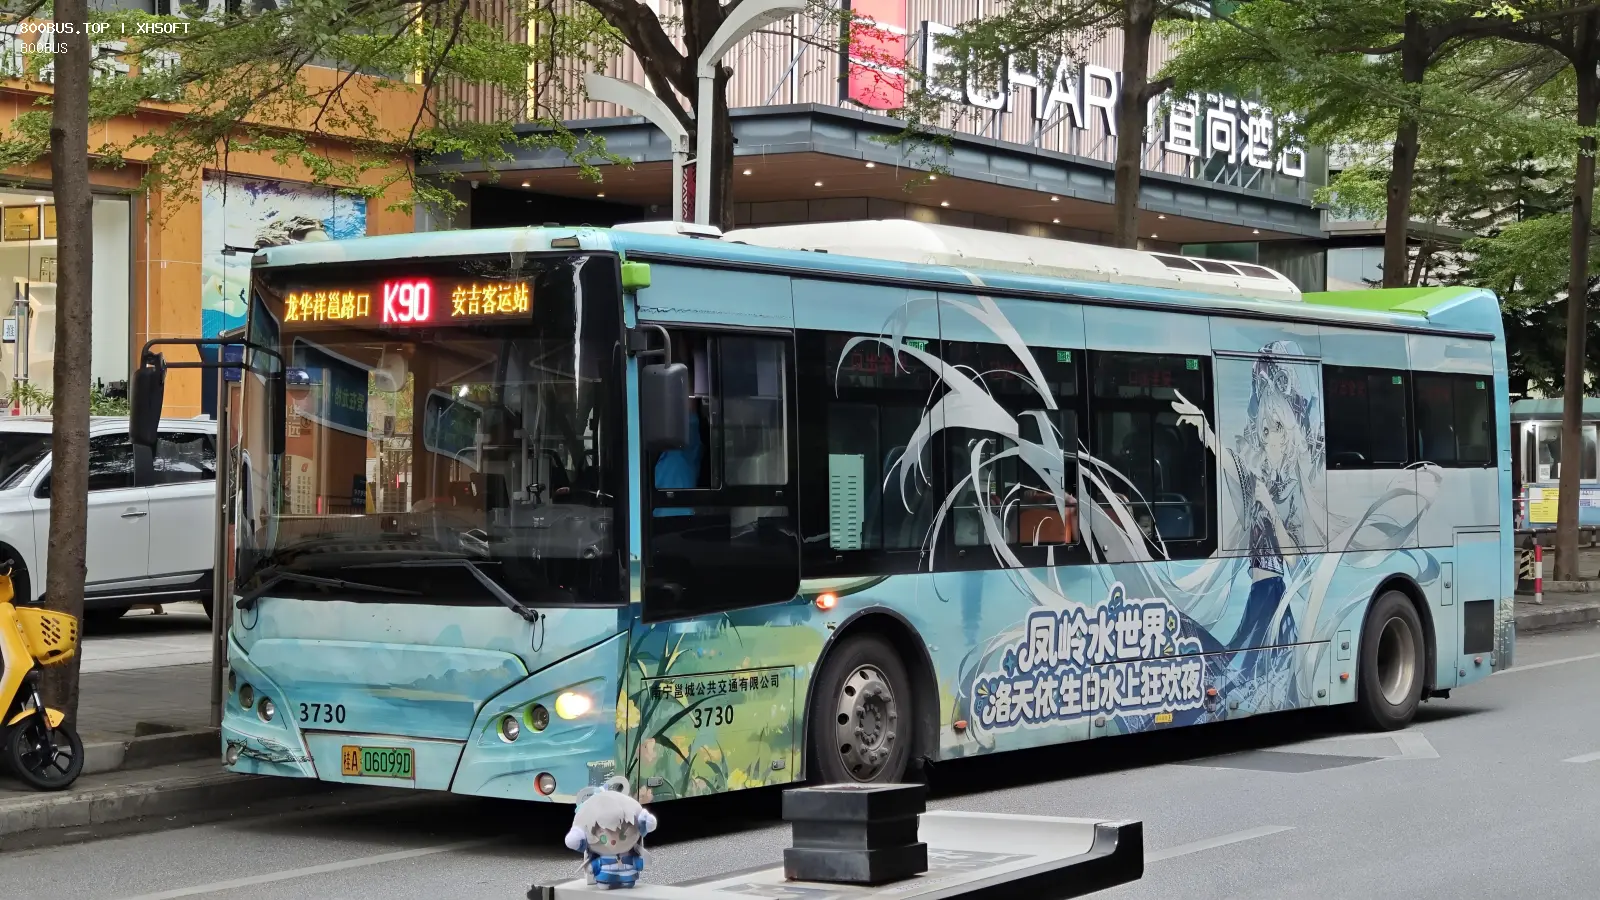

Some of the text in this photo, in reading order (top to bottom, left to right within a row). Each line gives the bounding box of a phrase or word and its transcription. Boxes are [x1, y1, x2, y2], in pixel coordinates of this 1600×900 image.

[284, 290, 370, 322] 龙华祥邕路口
[382, 281, 431, 323] K90
[451, 282, 529, 317] 安吉客运站
[1018, 608, 1166, 672] 凤岭水世界
[651, 674, 780, 701] 南宁邕城公共交通有限公司
[983, 662, 1200, 724] 洛天依生日水上狂欢夜
[299, 702, 346, 724] 3730
[693, 703, 735, 730] 3730
